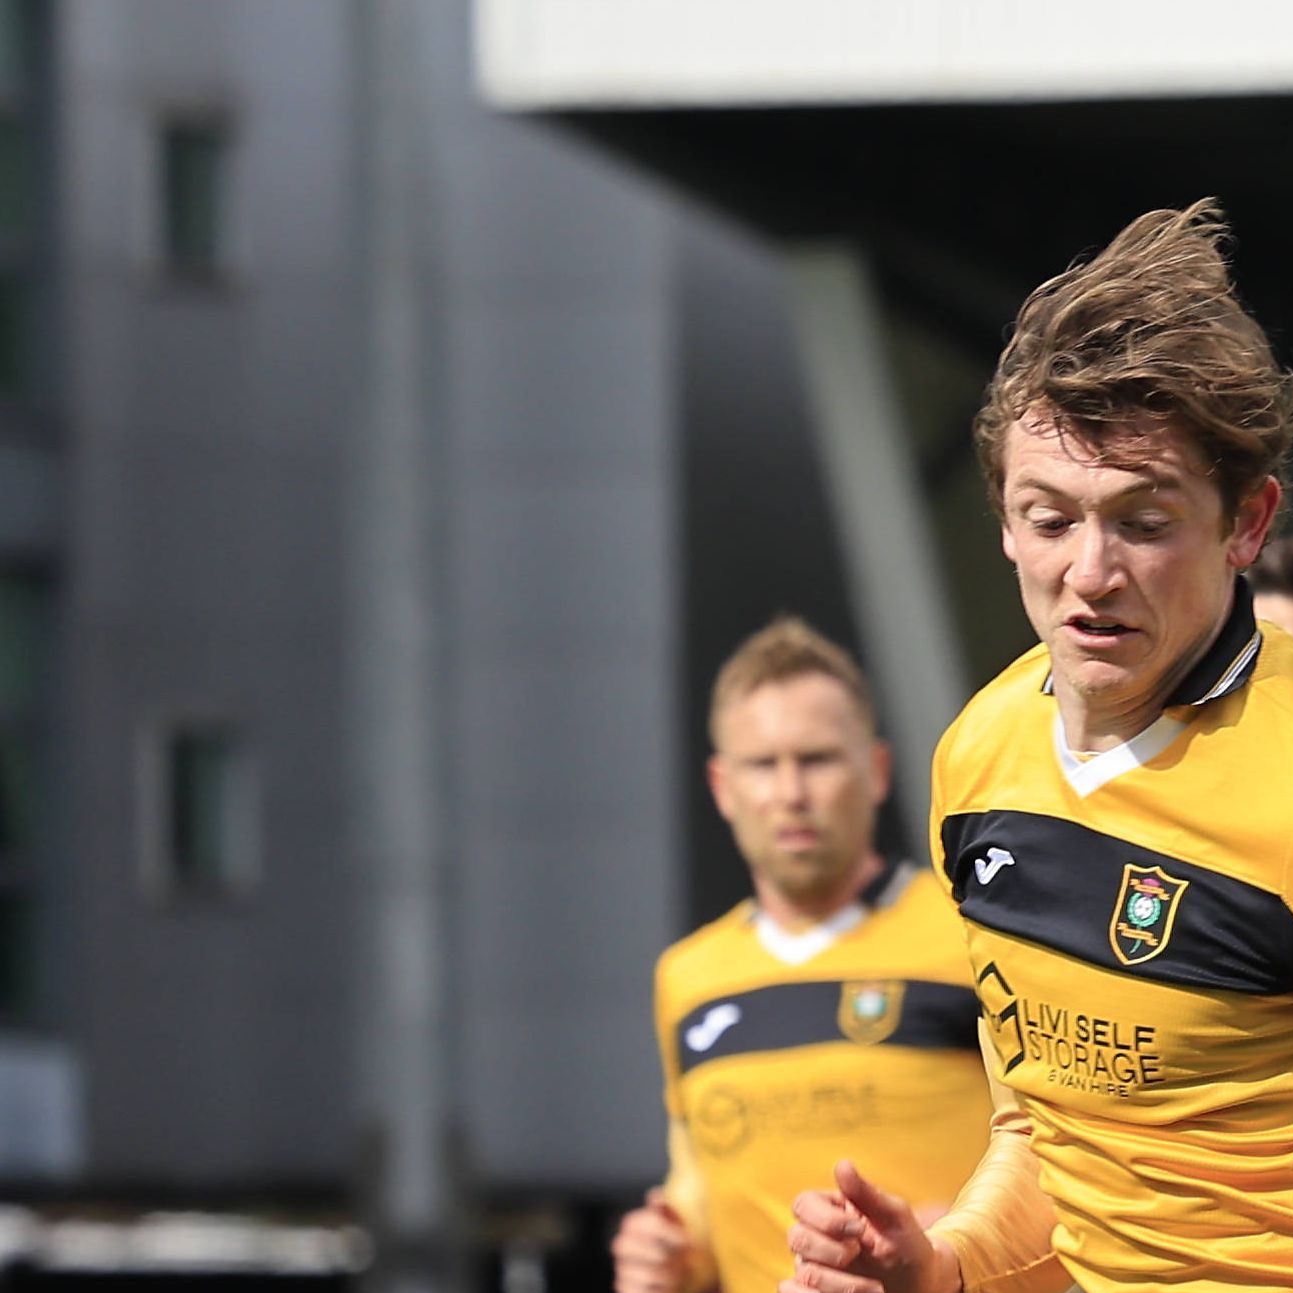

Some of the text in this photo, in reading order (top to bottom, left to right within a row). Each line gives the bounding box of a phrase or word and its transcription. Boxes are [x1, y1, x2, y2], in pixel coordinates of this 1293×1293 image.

[1023, 998, 1156, 1052] LIVI SELF
[1026, 1029, 1166, 1085] STORAGE
[1058, 1071, 1087, 1092] VAN
